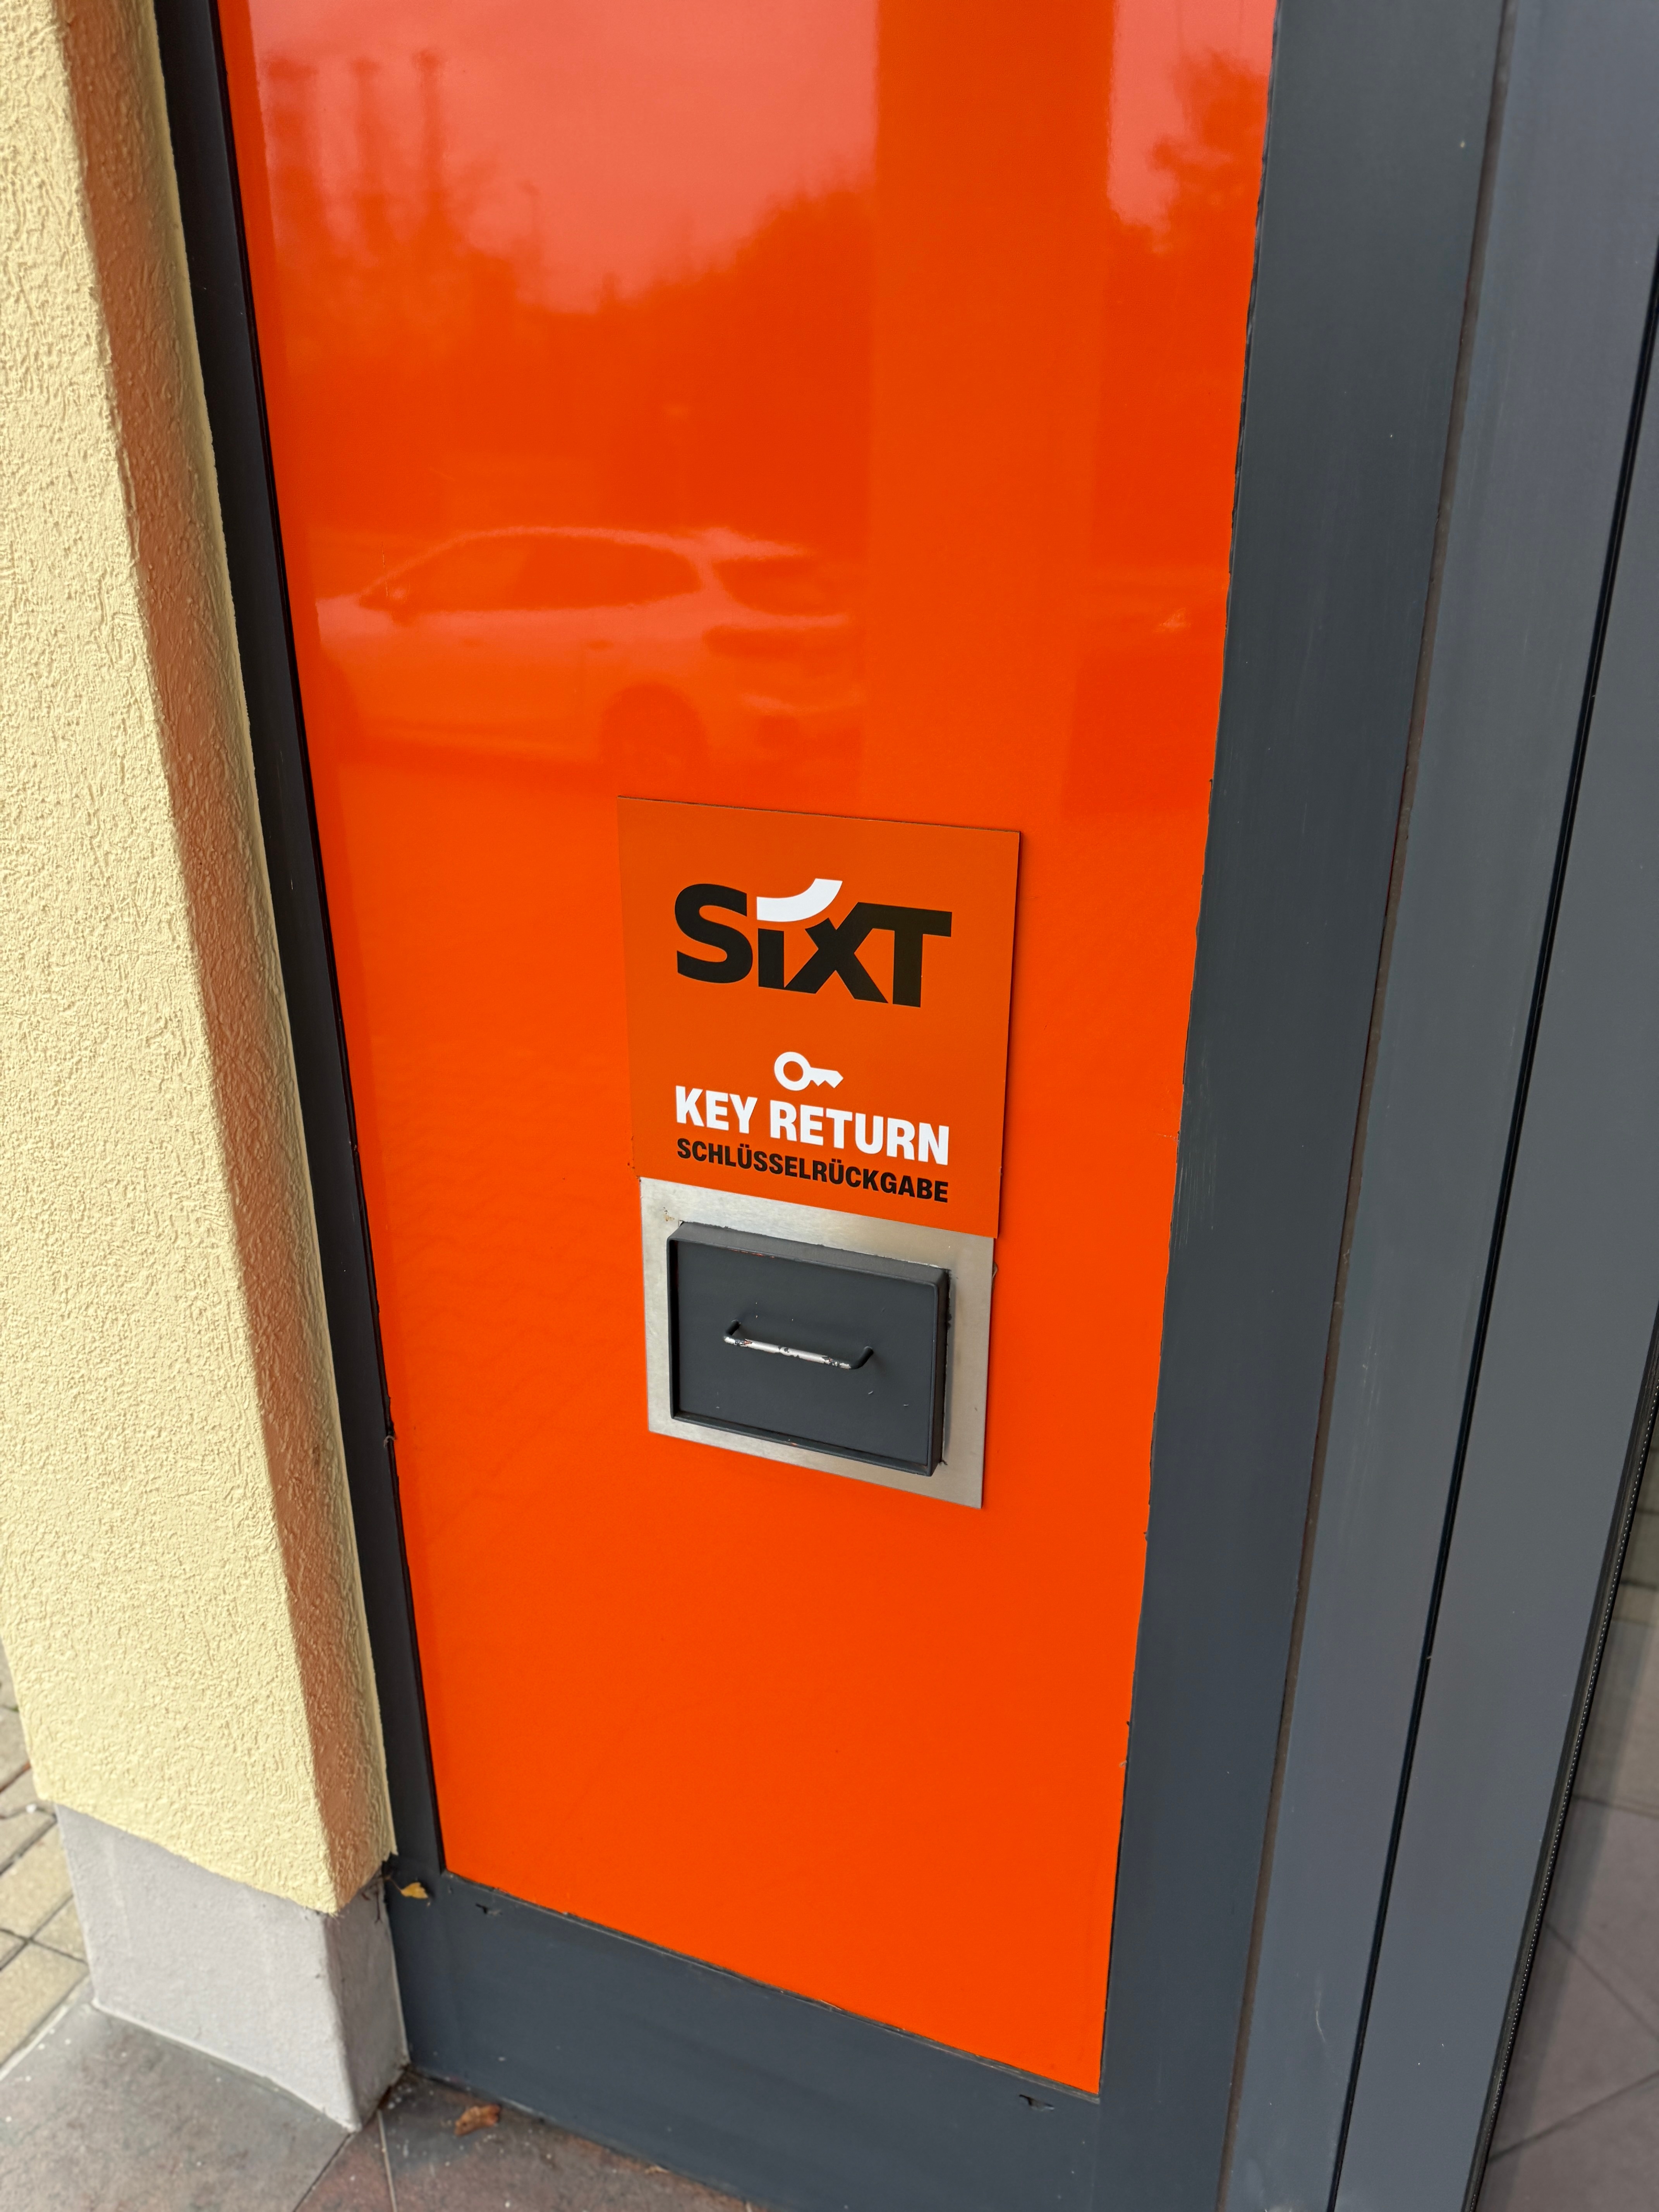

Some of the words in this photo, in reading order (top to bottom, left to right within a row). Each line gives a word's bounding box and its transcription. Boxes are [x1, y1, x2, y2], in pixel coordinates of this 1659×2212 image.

[675, 1085, 758, 1134] KEY
[770, 1100, 949, 1165] RETURN
[677, 1138, 948, 1203] SCHLÜSSELRÜCKGABE
